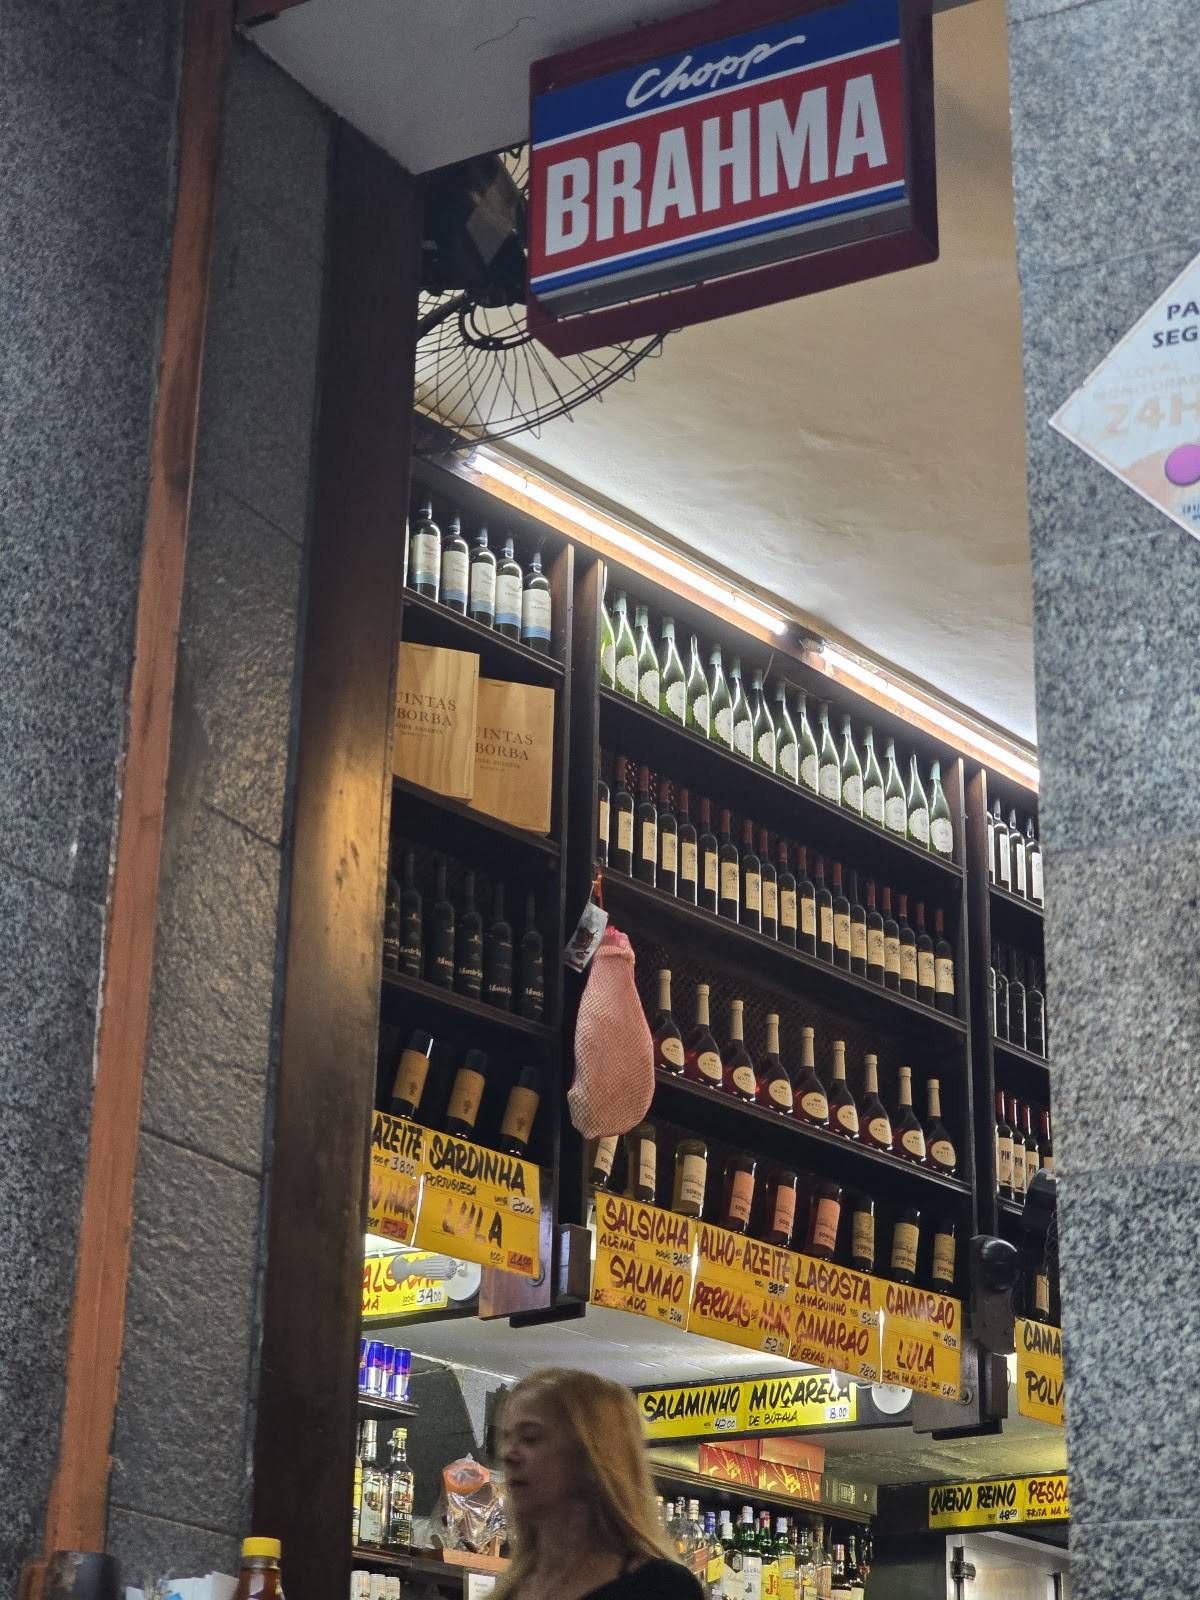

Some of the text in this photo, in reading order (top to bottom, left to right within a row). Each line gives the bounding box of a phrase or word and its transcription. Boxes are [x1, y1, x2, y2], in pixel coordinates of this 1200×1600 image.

[626, 34, 806, 108] Chopp
[545, 74, 887, 256] BRAHMA
[1167, 301, 1200, 320] PA
[1152, 326, 1198, 349] SEG
[397, 707, 452, 726] BORBA
[475, 742, 528, 761] BORBA
[371, 1113, 423, 1161] AZEITE
[423, 1171, 477, 1196] PORTUGUESA
[429, 1134, 526, 1197] SARDINHA
[602, 1197, 689, 1252] SALSICHA
[700, 1226, 735, 1267] ALHO
[742, 1240, 790, 1284] AZEITE
[795, 1257, 871, 1311] LAGOSTA
[794, 1292, 847, 1317] CAVAQUINHO
[886, 1284, 955, 1330] CAMARÃO
[896, 1338, 935, 1375] LULA
[643, 1385, 741, 1422] SALAMINHO
[749, 1376, 851, 1412] MUÇARELA
[749, 1415, 760, 1426] DE
[931, 1482, 1017, 1515] QUEIJO REINO
